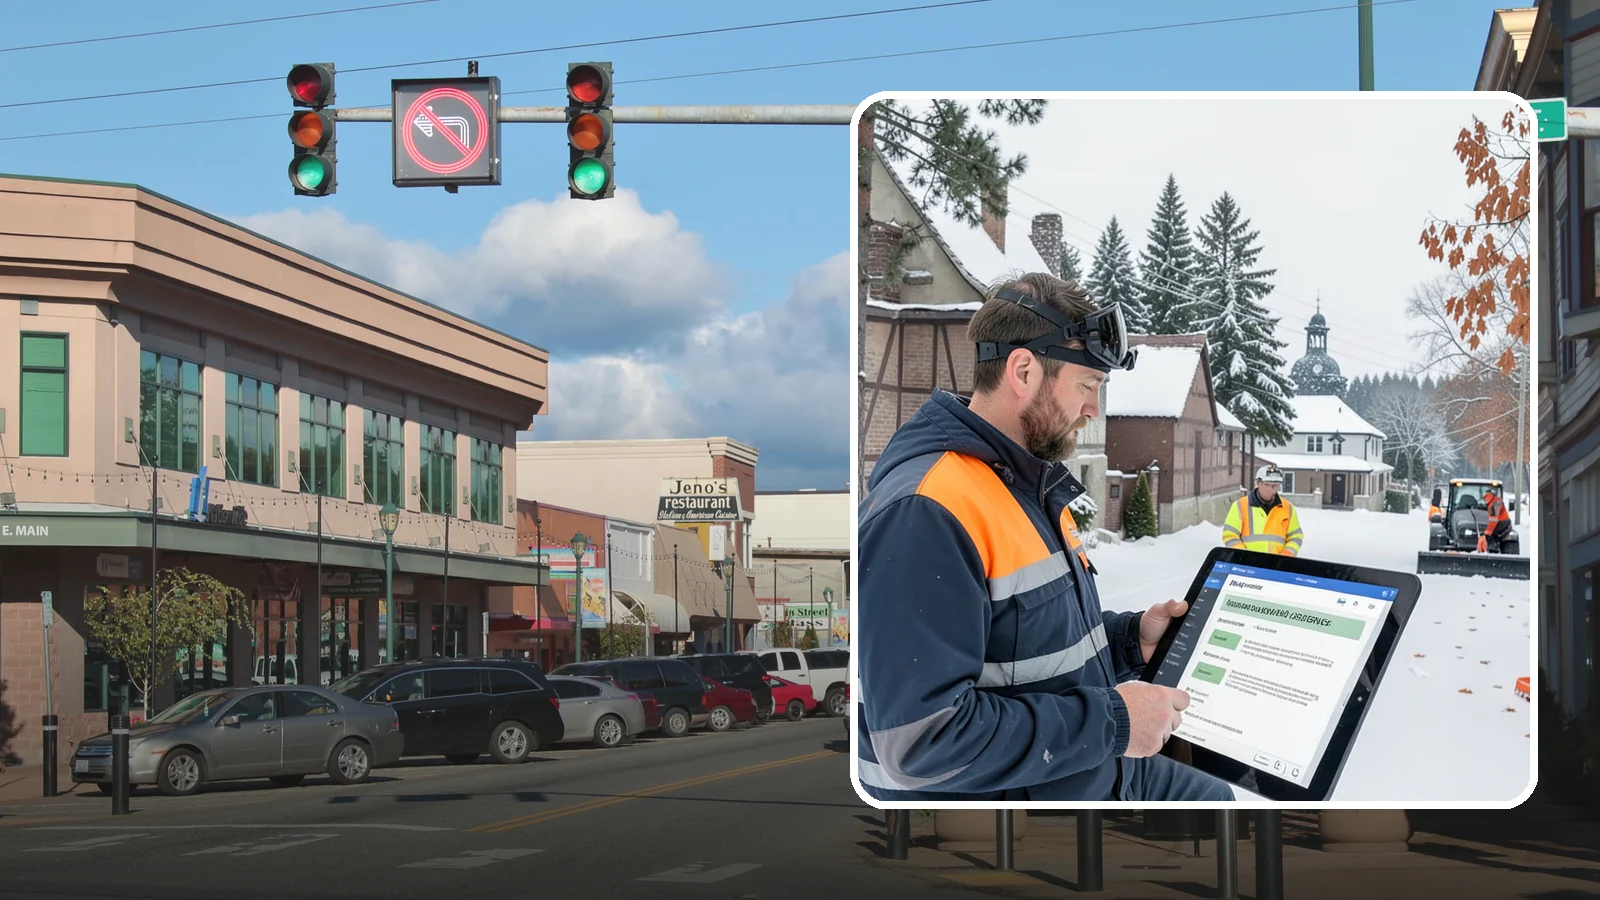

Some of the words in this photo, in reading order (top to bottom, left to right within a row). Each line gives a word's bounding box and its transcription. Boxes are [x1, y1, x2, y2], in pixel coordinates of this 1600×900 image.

[669, 480, 727, 494] Jeno's
[665, 496, 731, 509] restaurant
[658, 509, 681, 519] Italian
[686, 509, 715, 519] American
[715, 509, 738, 519] Cuisine
[2, 525, 13, 536] E.
[15, 525, 49, 536] MAIN
[797, 607, 829, 617] Street
